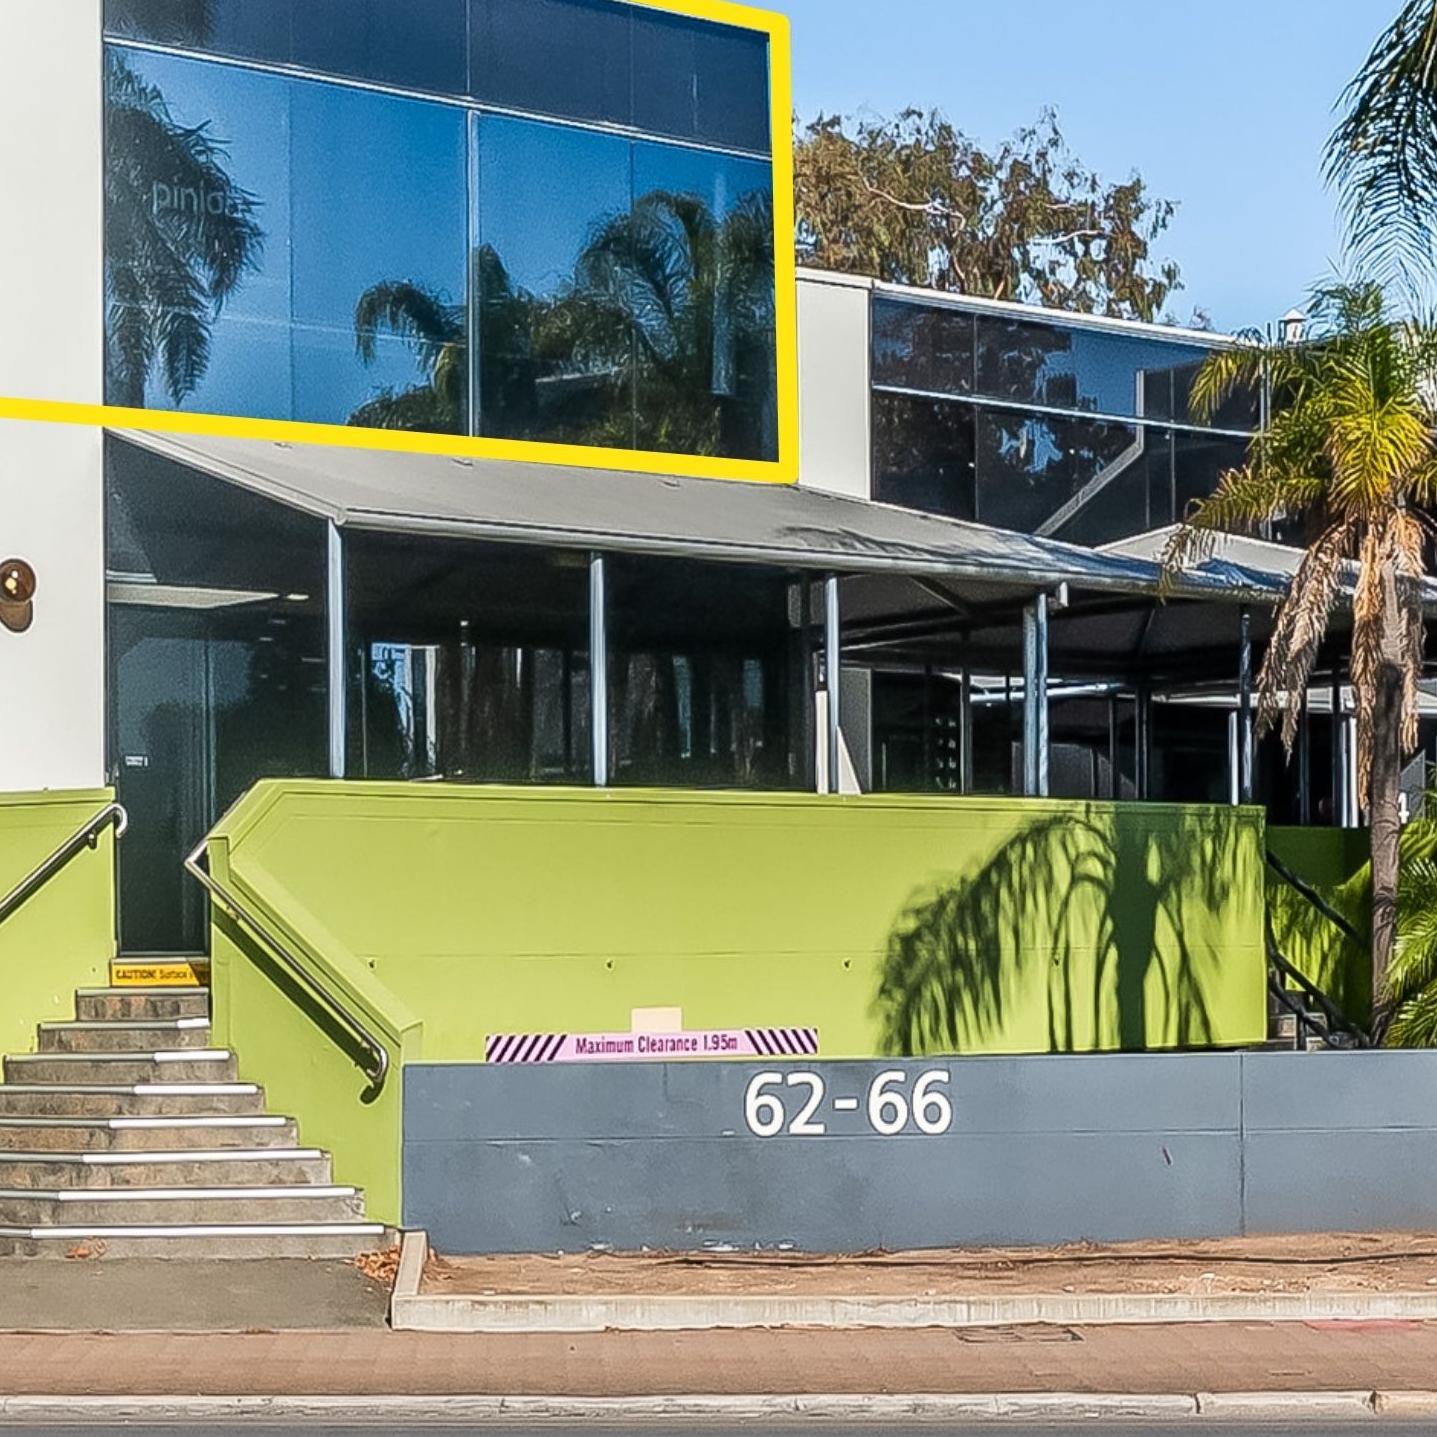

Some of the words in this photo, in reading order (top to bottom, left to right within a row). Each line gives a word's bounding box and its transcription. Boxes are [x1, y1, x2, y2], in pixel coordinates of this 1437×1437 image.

[576, 1036, 634, 1054] Maximum
[638, 1034, 698, 1053] Clearance
[704, 1033, 737, 1051] 1.95m
[744, 1070, 953, 1137] 62-66
